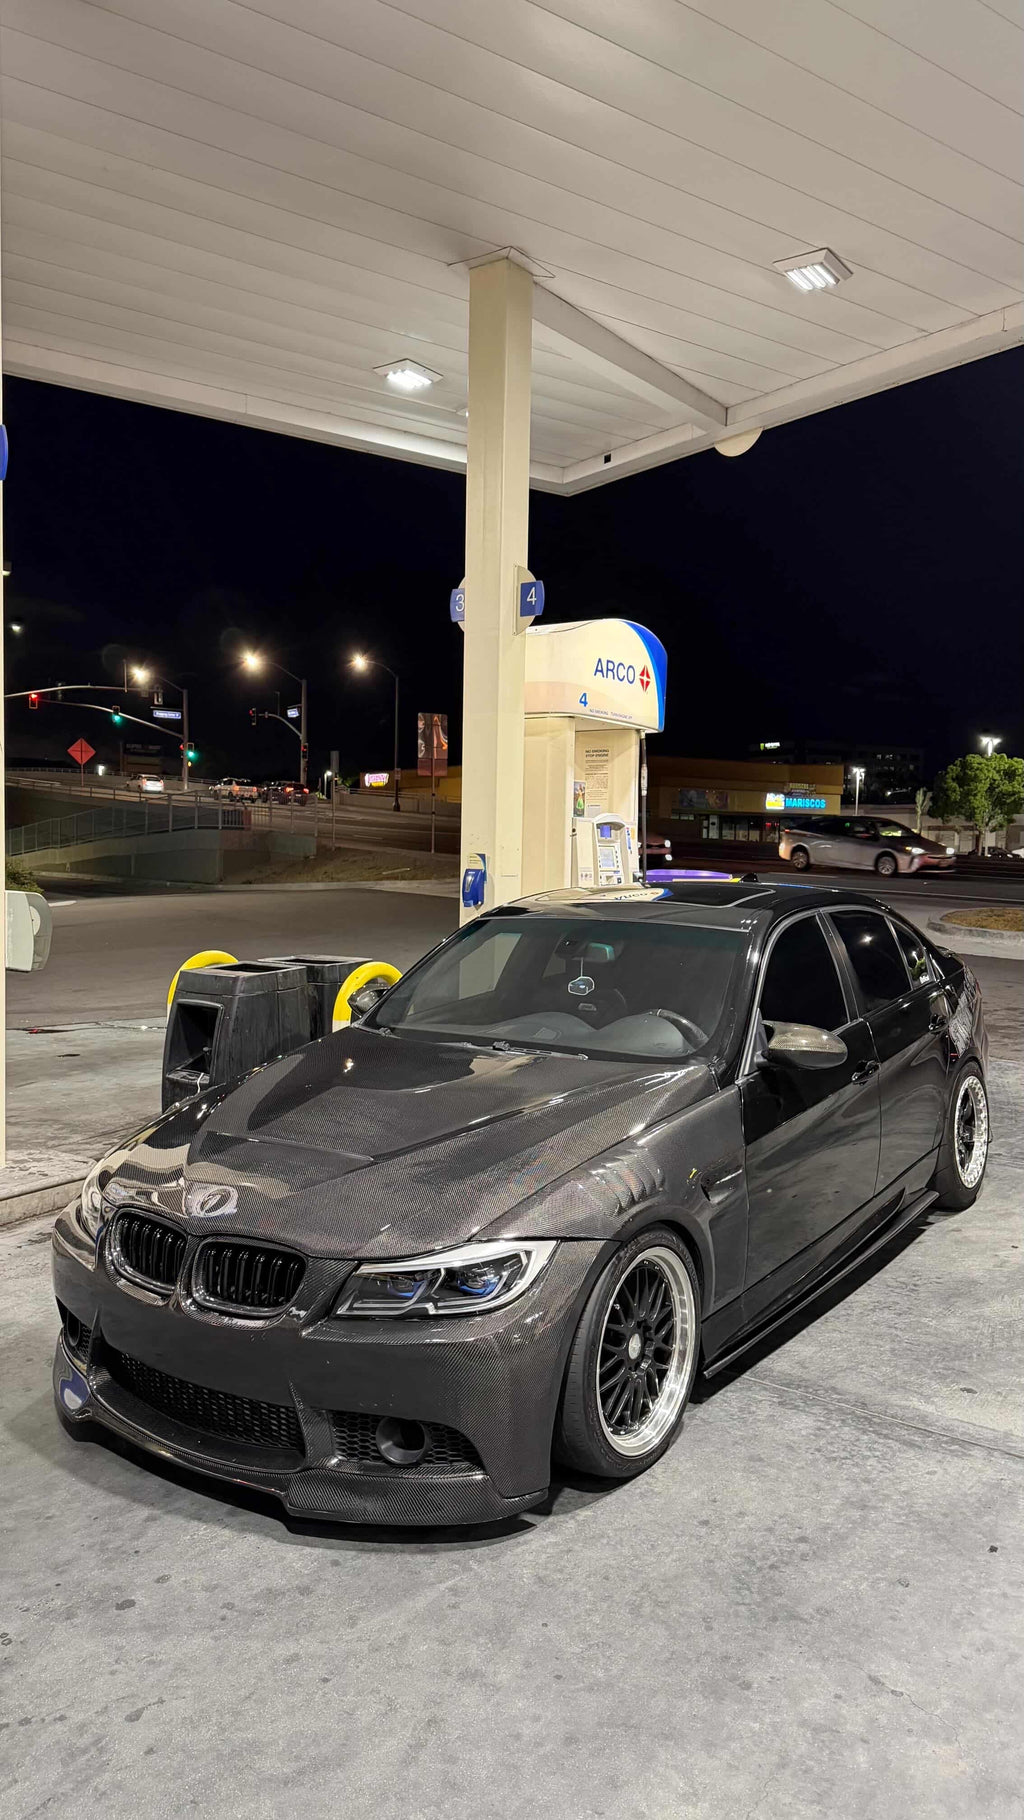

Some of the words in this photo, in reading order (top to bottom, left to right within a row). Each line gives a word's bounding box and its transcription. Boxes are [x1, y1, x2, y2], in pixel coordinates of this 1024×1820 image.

[455, 594, 464, 611] 3
[526, 587, 537, 605] 4
[594, 658, 635, 684] ARCO
[579, 693, 588, 707] 4
[785, 798, 826, 809] MARISCOS
